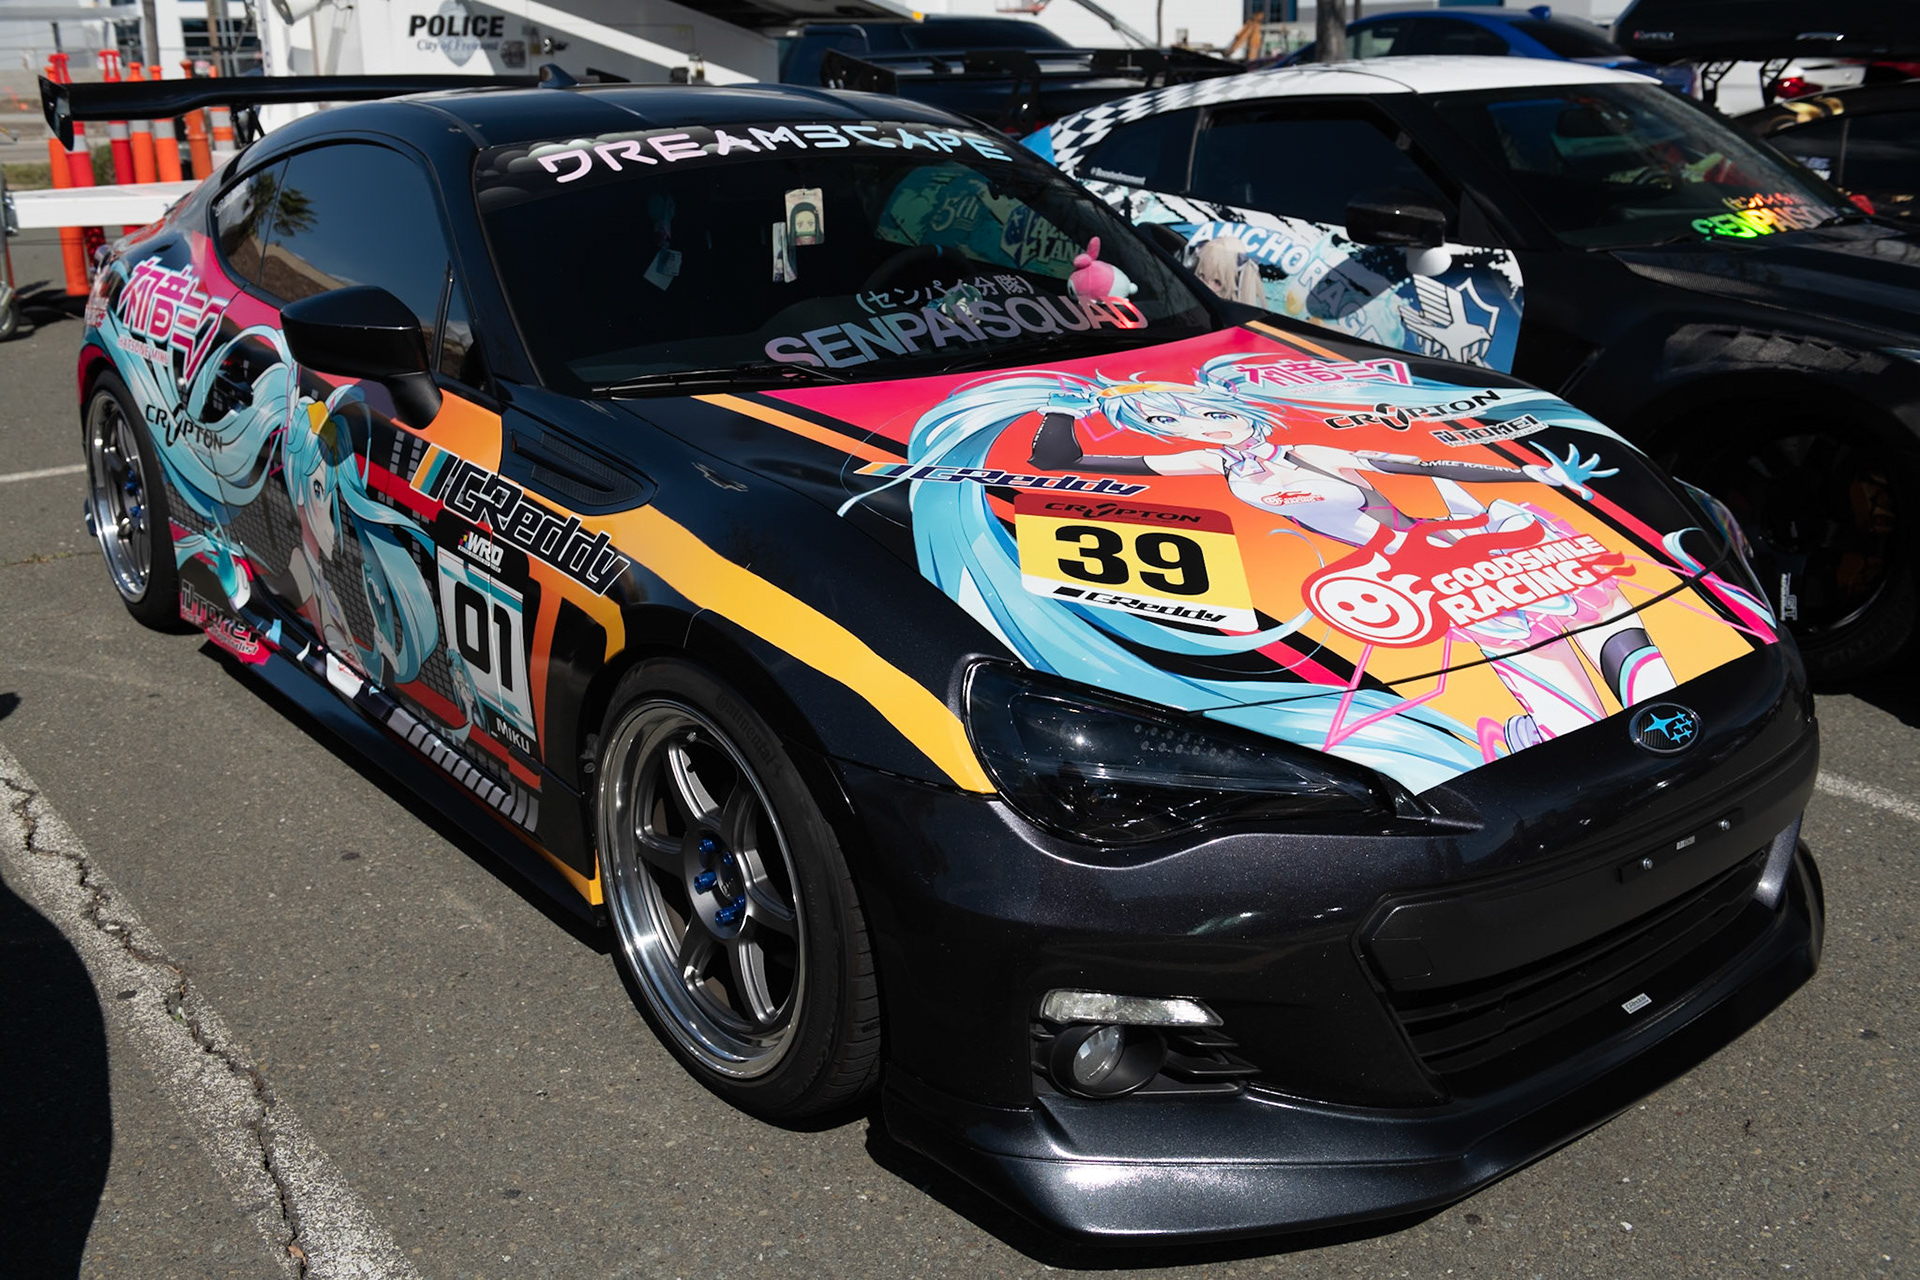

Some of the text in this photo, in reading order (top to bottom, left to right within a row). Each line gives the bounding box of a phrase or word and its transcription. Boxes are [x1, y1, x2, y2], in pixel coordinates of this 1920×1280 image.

[408, 15, 505, 37] POLICE
[417, 39, 438, 52] City
[117, 256, 230, 389] 初音ミク
[118, 334, 150, 358] HATSUNE
[764, 295, 1149, 369] SENPAISQUAD
[1234, 358, 1414, 387] 初音ミク
[145, 401, 223, 455] CRYPTON
[1324, 389, 1502, 431] CRYPTON
[909, 465, 1149, 496] GReddy
[443, 460, 630, 596] GReddy
[1044, 502, 1202, 523] CRYPTON
[467, 531, 504, 567] WRD
[1055, 525, 1210, 596] 39
[1430, 536, 1607, 595] GOODSMILE
[1085, 591, 1228, 623] GReddy
[1437, 560, 1598, 626] RACING
[455, 581, 513, 692] 01
[715, 693, 776, 766] Continental
